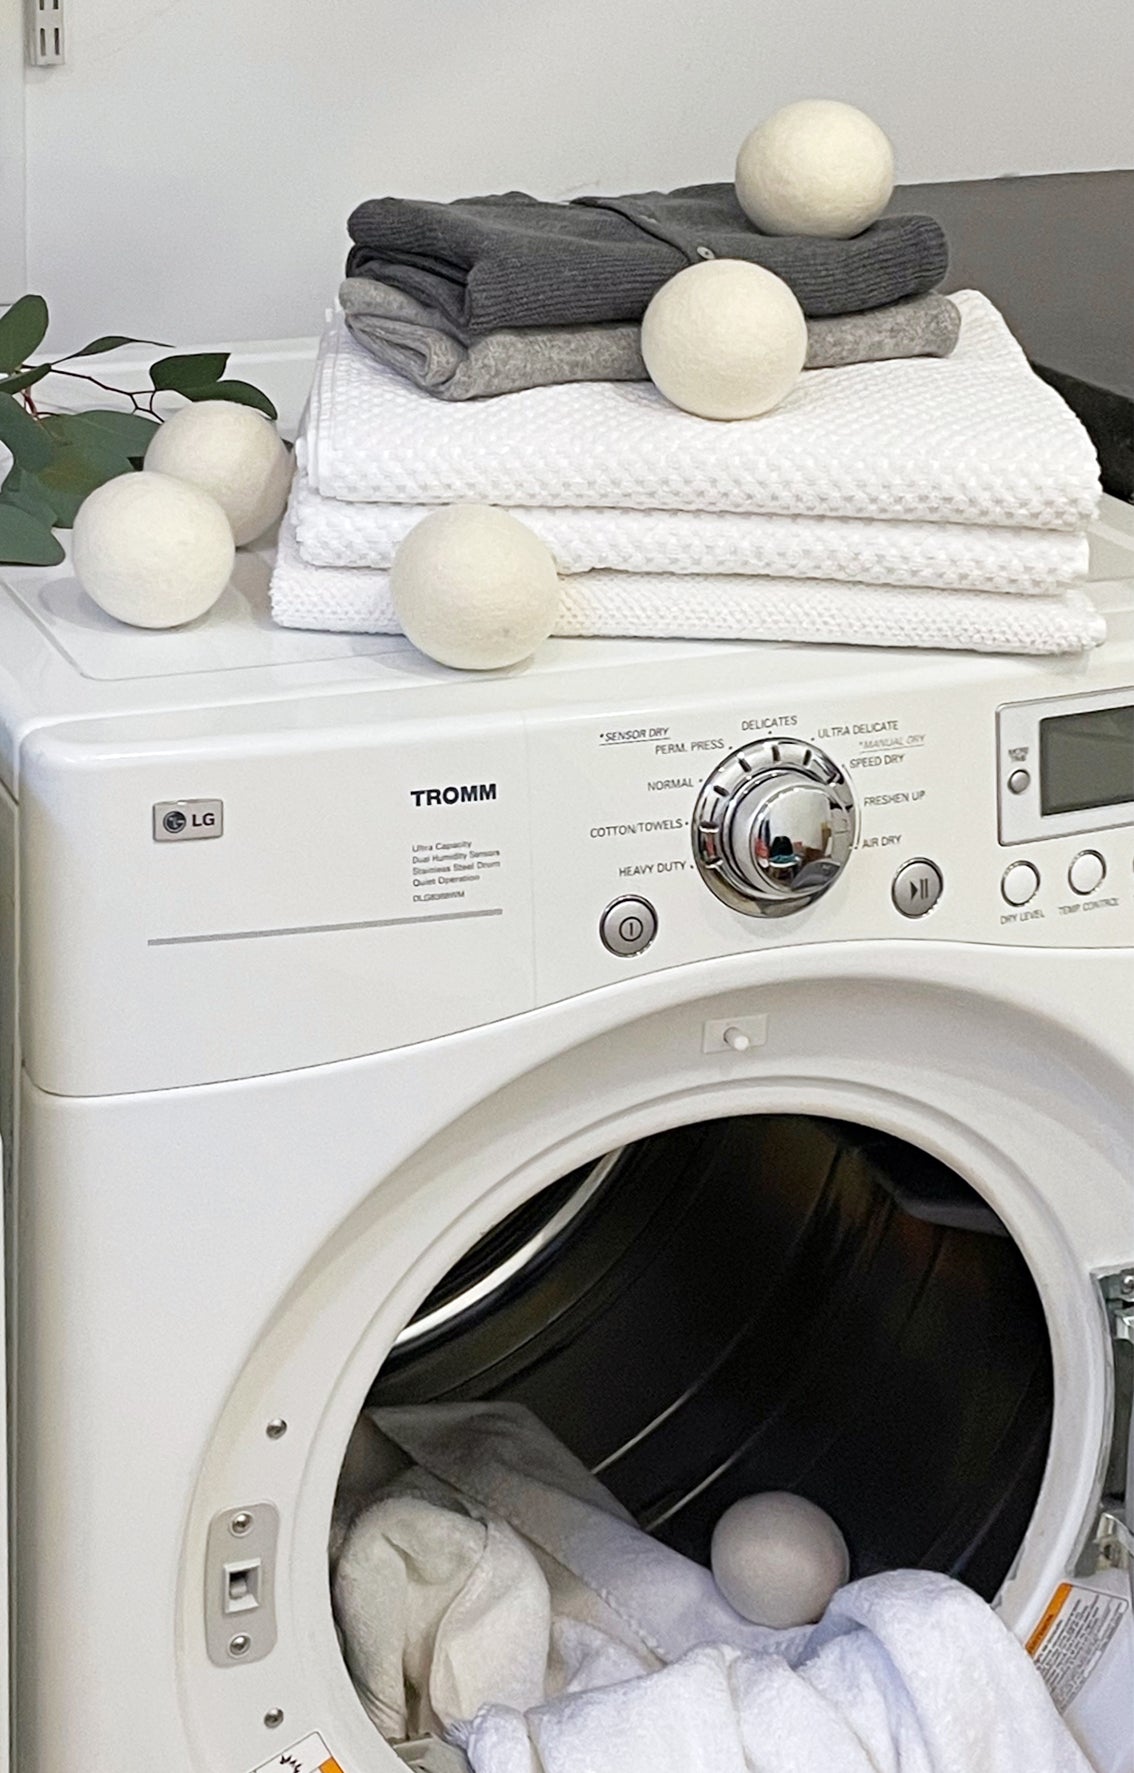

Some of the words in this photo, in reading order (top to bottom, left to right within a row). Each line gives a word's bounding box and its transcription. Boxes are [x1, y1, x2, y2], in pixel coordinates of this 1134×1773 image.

[741, 715, 798, 731] DELICATES
[853, 720, 899, 736] DELICATE
[605, 729, 646, 742] SENSOR
[648, 727, 670, 738] DRY
[691, 738, 725, 752] PRESS
[849, 756, 882, 769] SPEED
[884, 753, 905, 765] DRY
[647, 778, 694, 792] NORMAL
[410, 783, 497, 806] TROMM
[911, 790, 926, 801] UP
[191, 812, 216, 827] LG
[881, 834, 902, 846] DRY
[618, 863, 655, 878] HEAVY
[656, 860, 687, 874] DUTY
